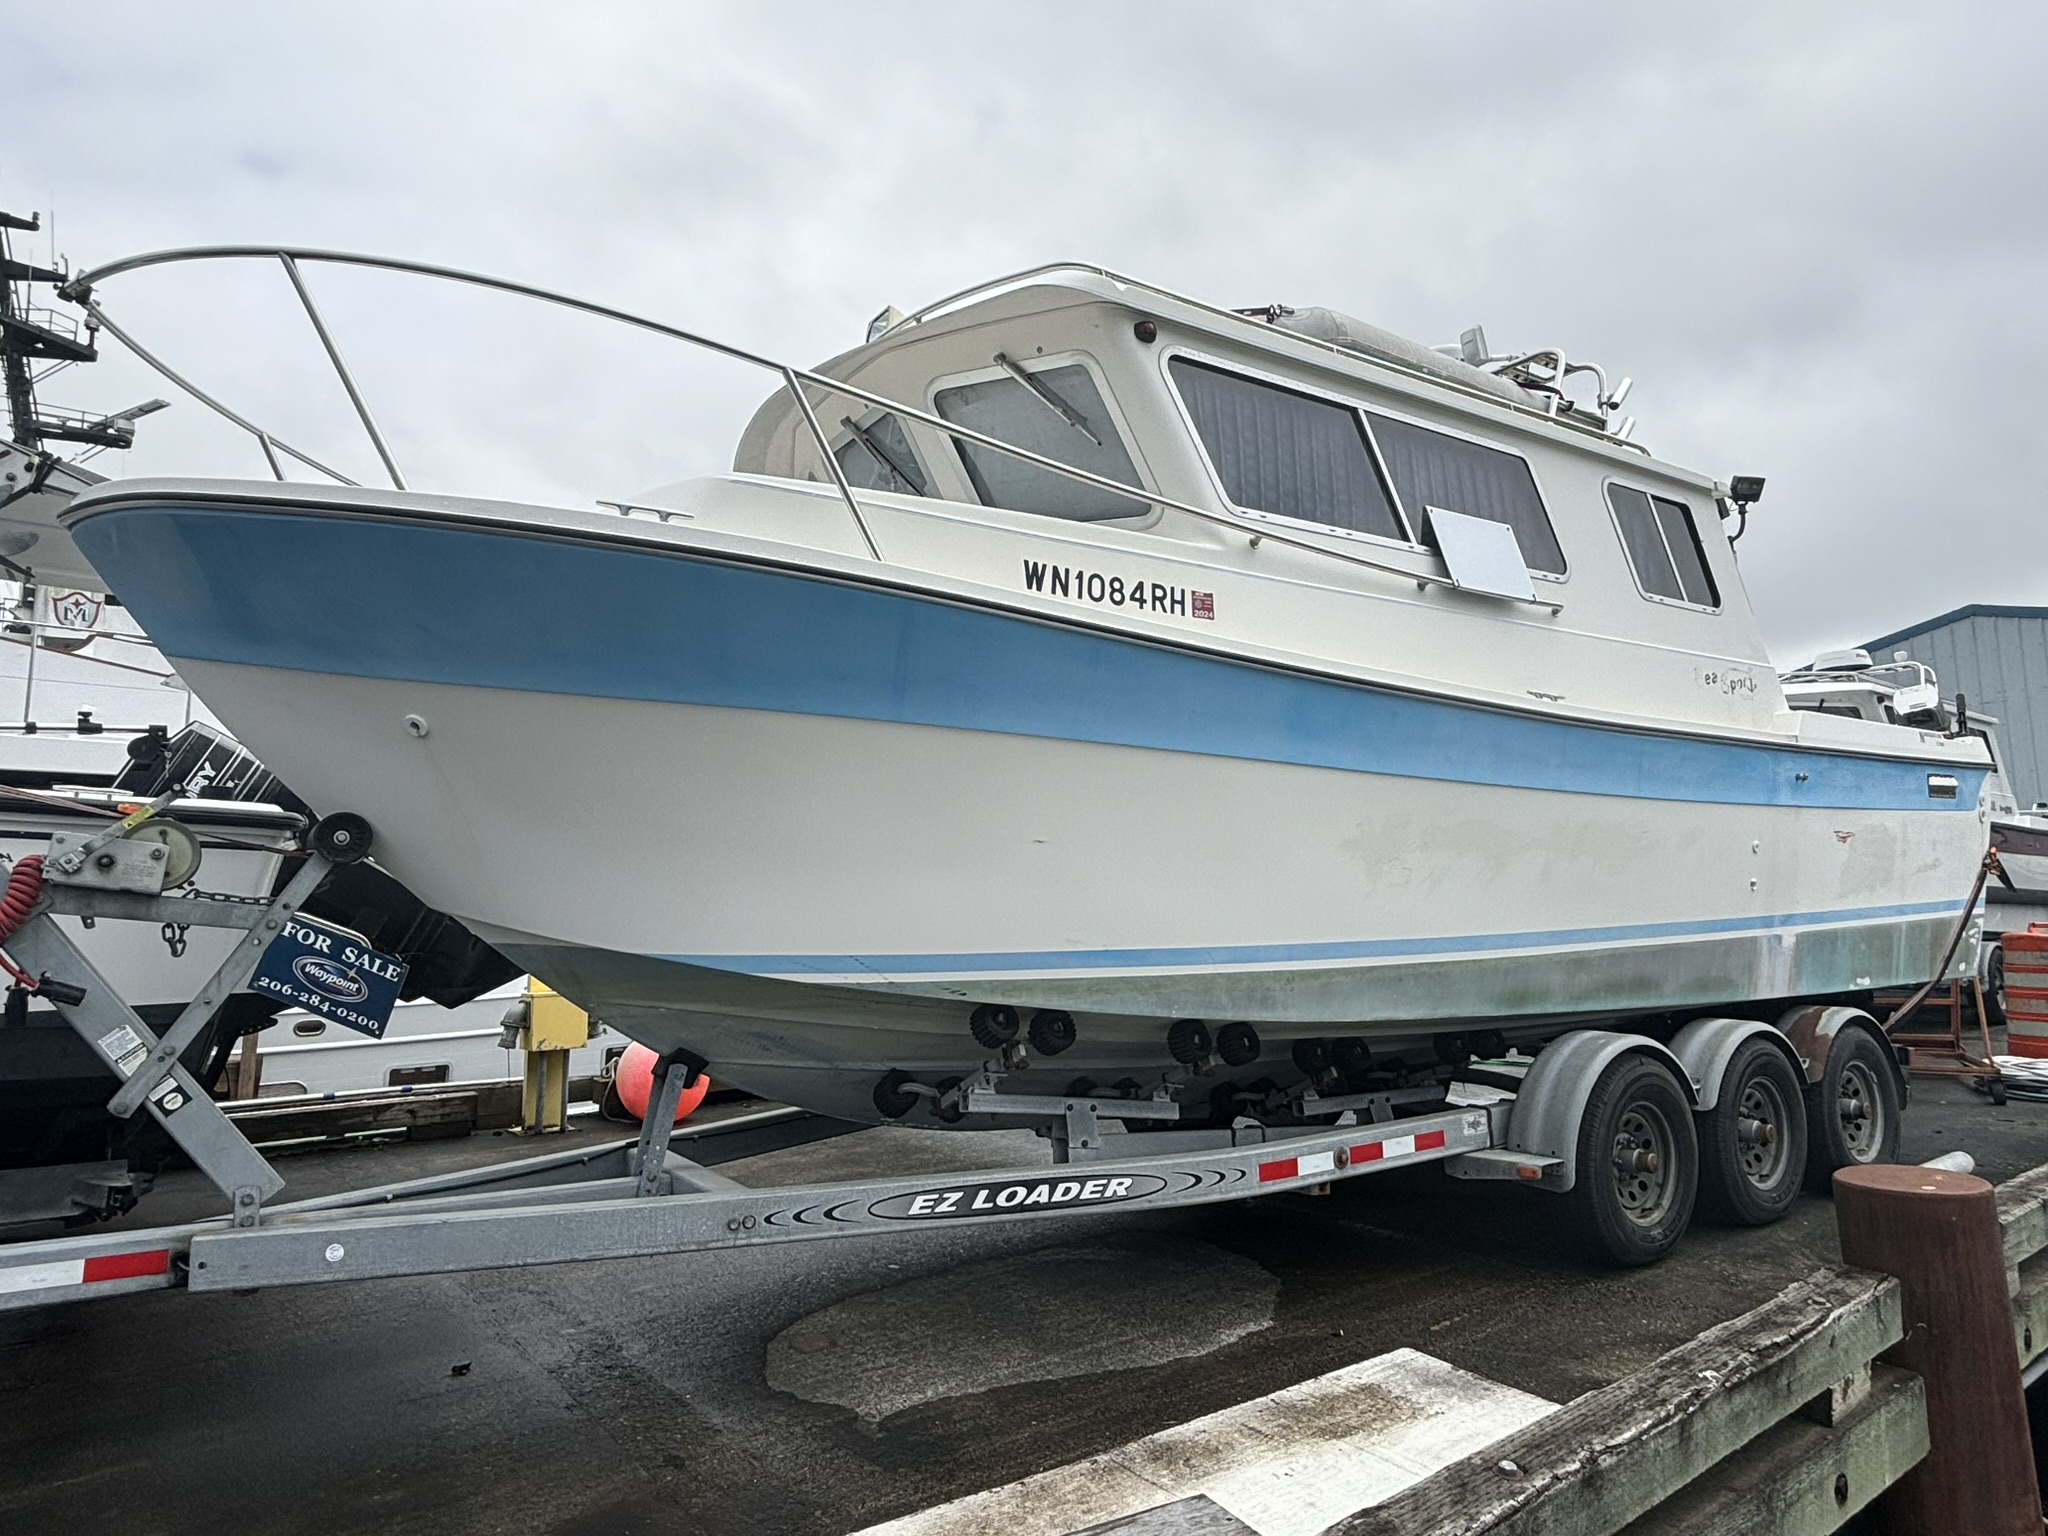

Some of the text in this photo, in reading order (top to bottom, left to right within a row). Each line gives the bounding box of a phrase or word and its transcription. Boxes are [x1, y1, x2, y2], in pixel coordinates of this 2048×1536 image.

[1023, 559, 1186, 617] WN1084RH
[1193, 609, 1214, 618] 2024
[280, 921, 401, 982] FOR SALE
[304, 962, 360, 993] Waypoint
[258, 976, 380, 1030] 206-284-0200
[907, 1177, 1133, 1216] EZ LOADER
